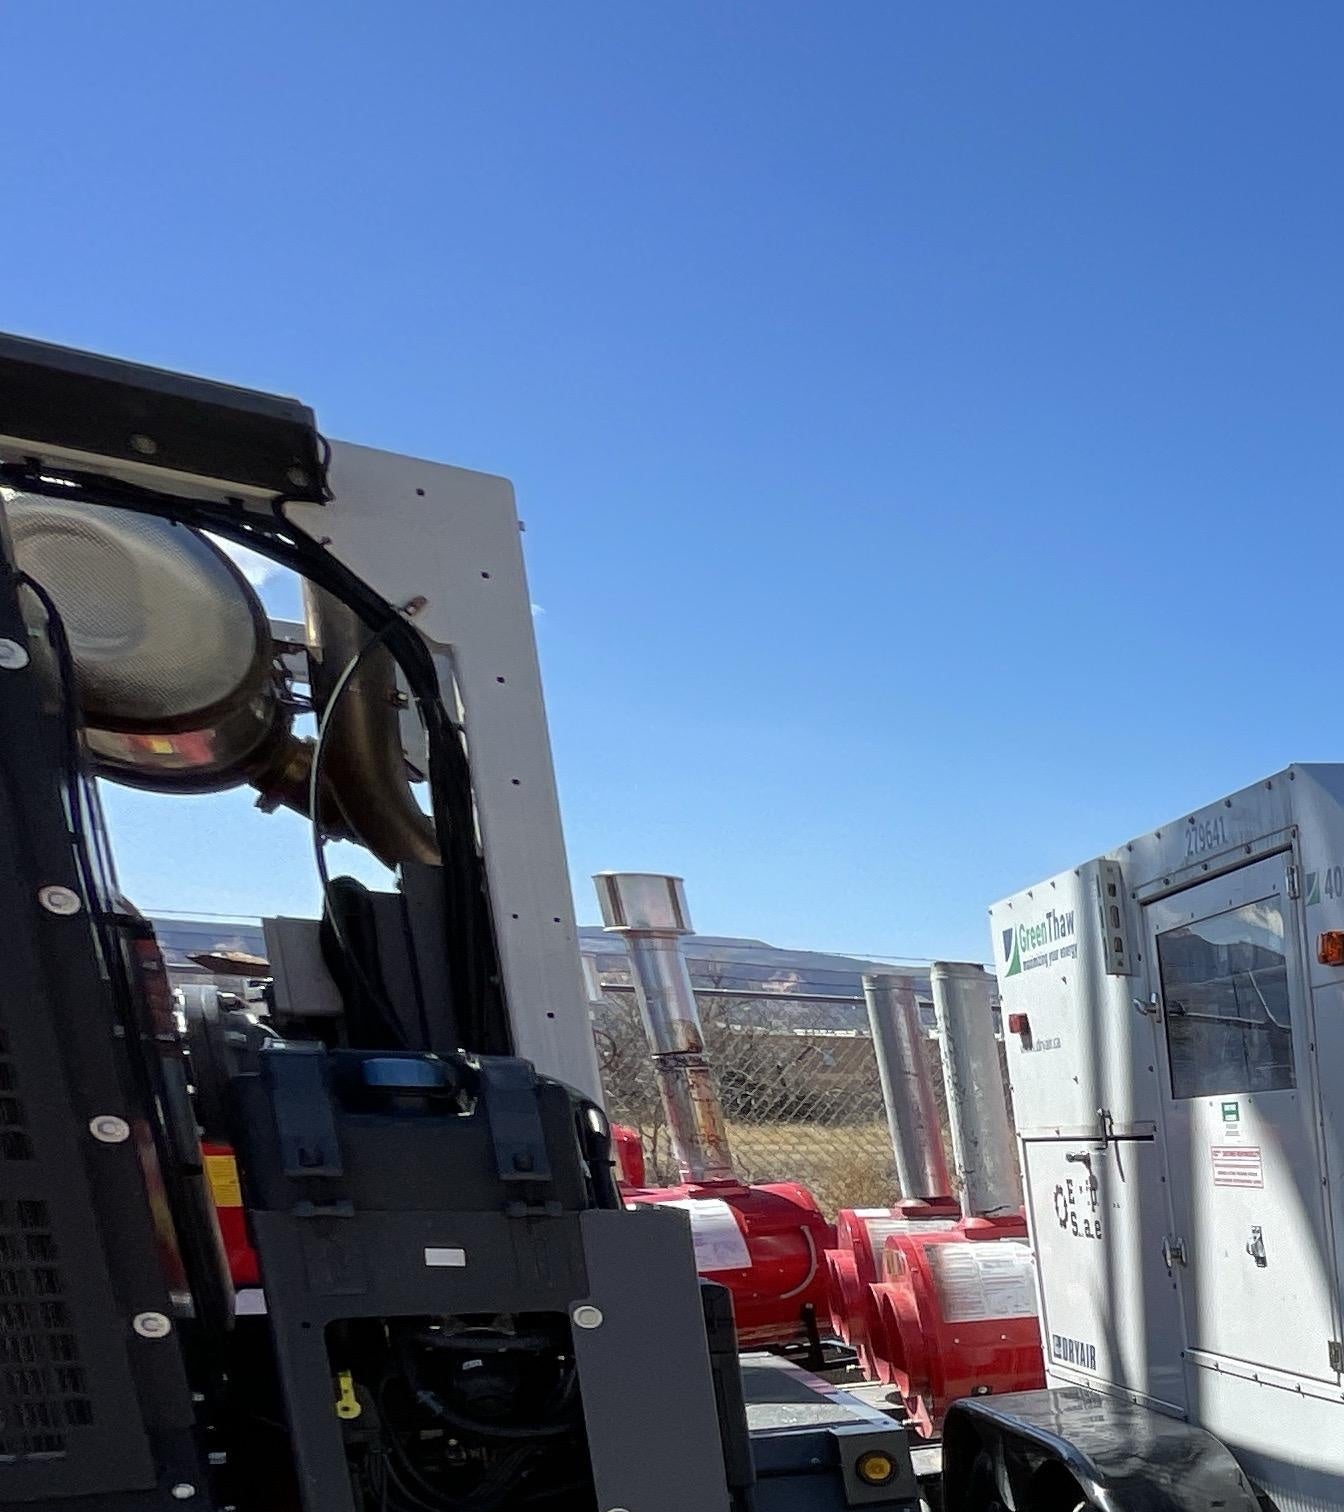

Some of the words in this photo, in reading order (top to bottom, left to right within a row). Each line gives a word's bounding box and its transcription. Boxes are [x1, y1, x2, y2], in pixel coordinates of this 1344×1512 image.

[1185, 816, 1227, 856] 279641
[1019, 908, 1075, 952] GreenThaw
[1062, 1337, 1097, 1371] DRYAIR
